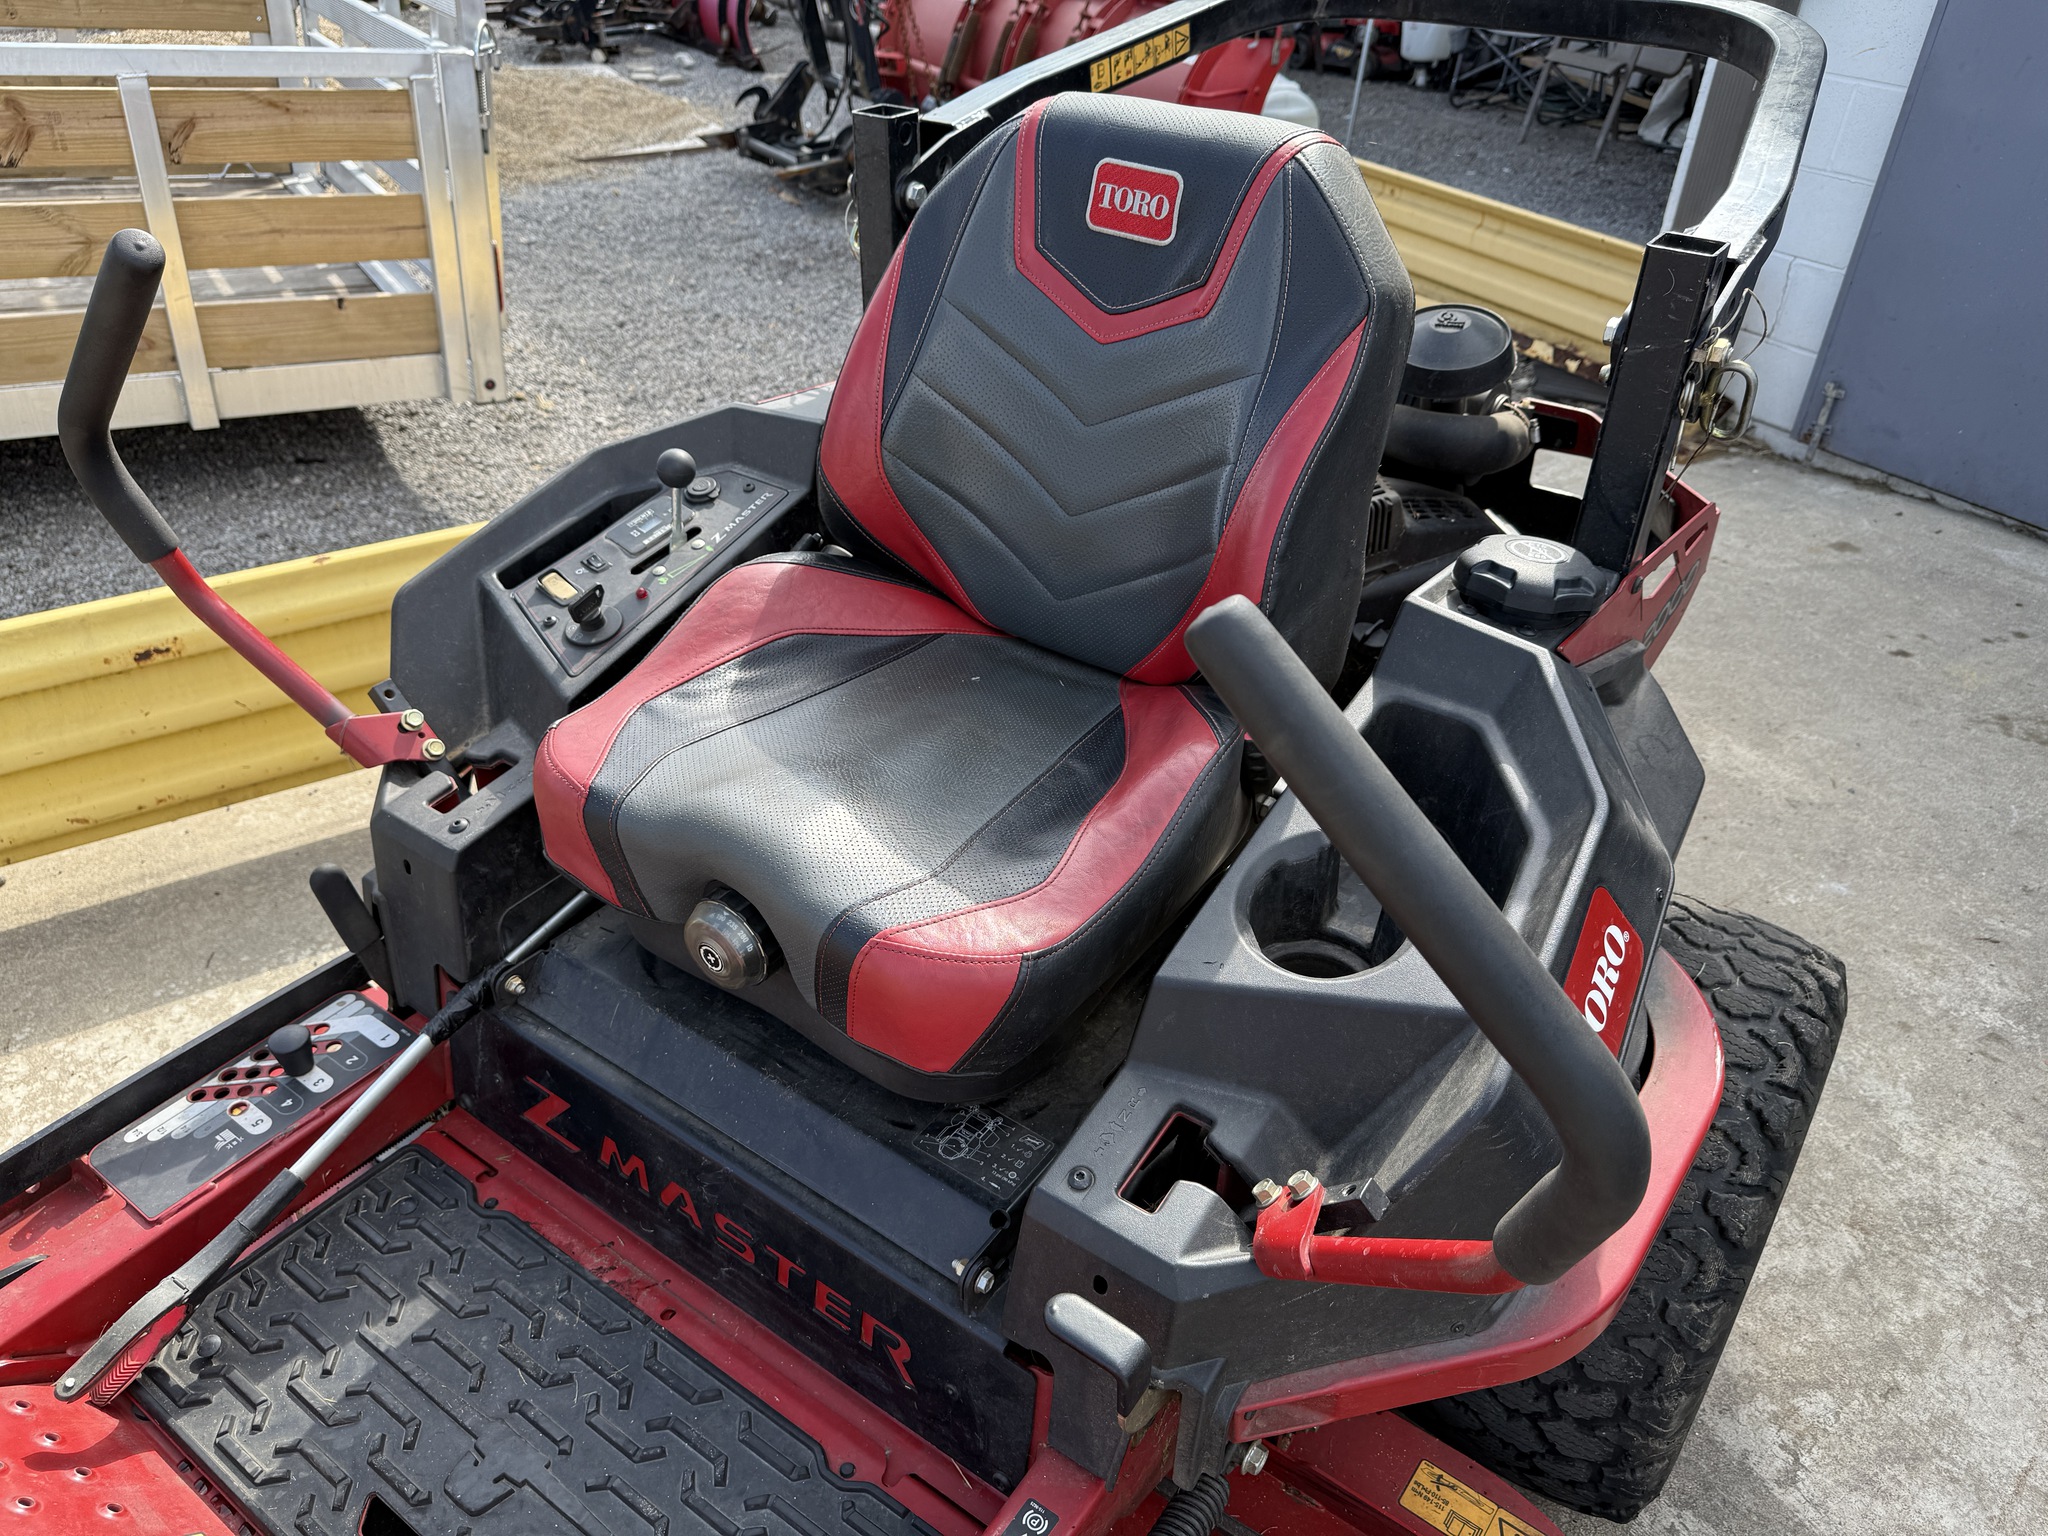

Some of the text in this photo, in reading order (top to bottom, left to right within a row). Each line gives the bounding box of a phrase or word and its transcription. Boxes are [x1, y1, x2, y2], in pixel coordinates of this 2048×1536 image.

[1098, 182, 1170, 220] TORO
[711, 492, 774, 544] Z MASTER
[726, 920, 738, 931] 235
[737, 930, 749, 943] 280
[746, 944, 754, 952] lb
[345, 1055, 360, 1065] 2
[313, 1078, 325, 1087] 3
[280, 1098, 293, 1107] 4
[251, 1118, 264, 1128] 5
[522, 1075, 918, 1394] Z MASTER
